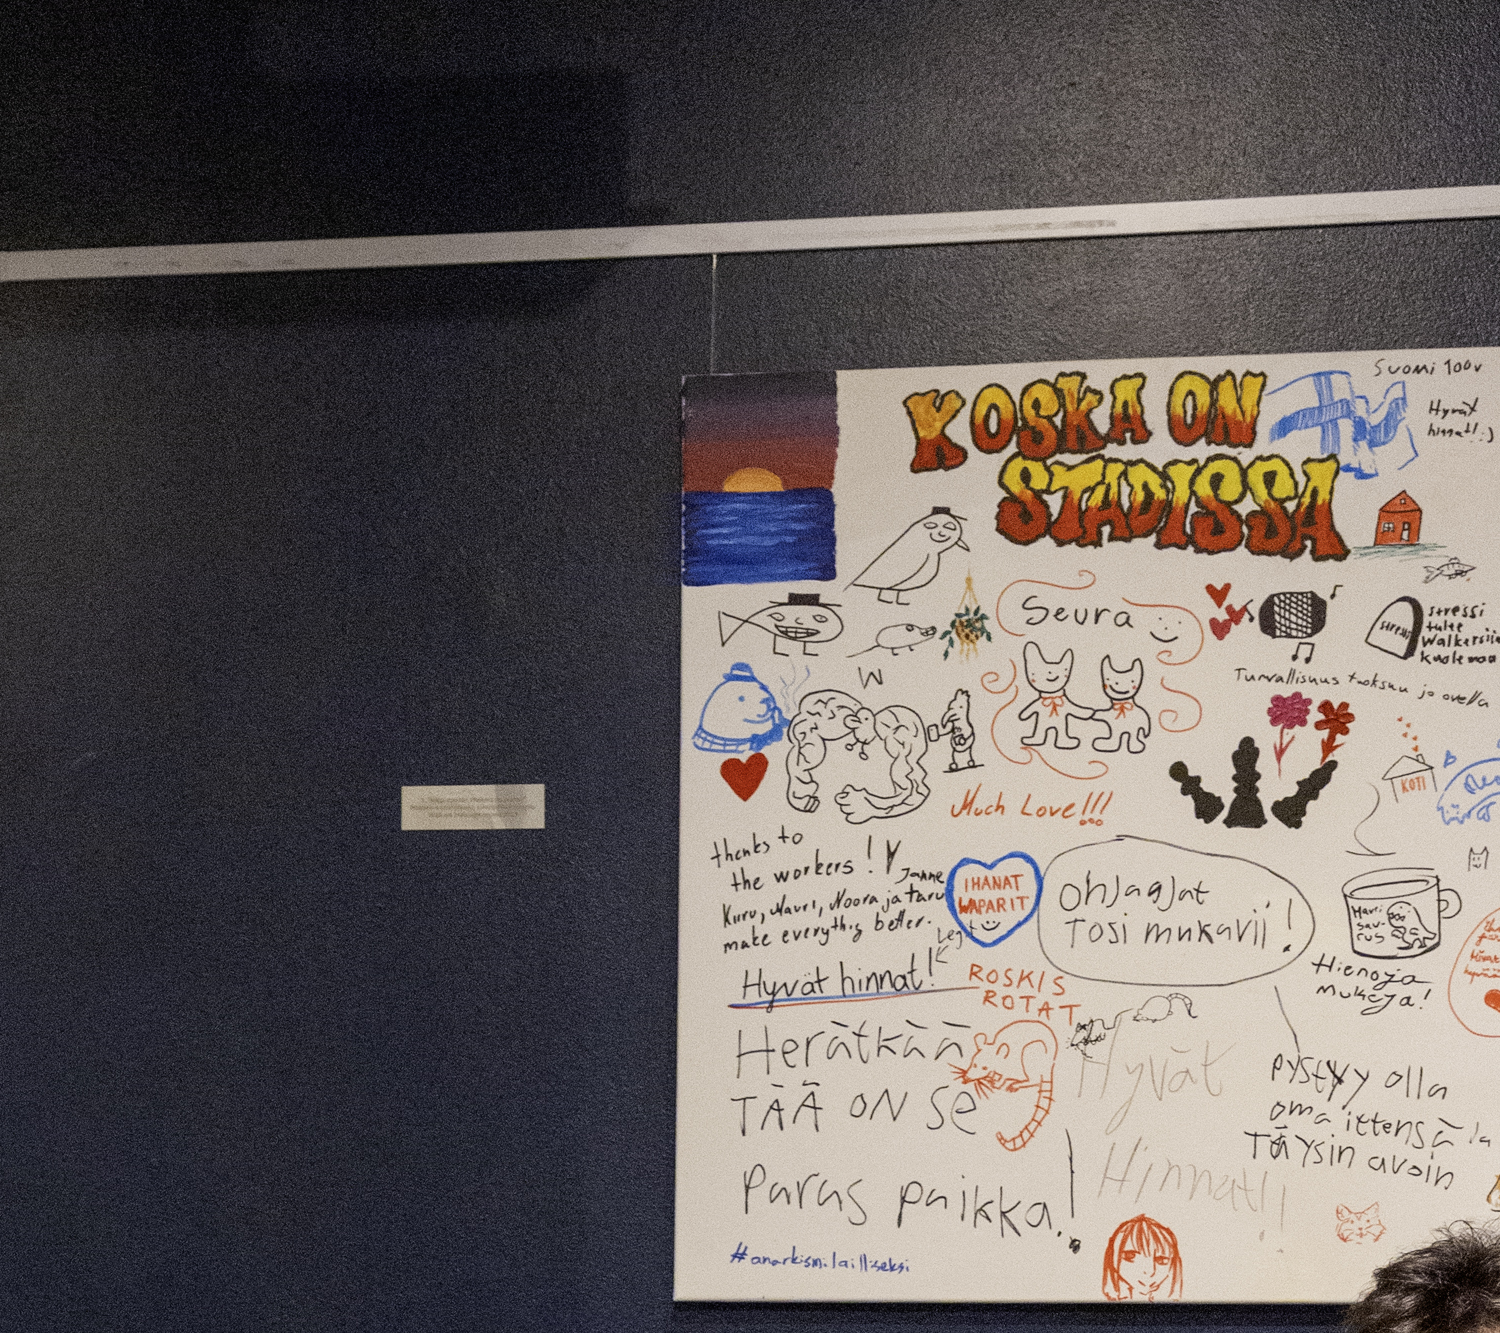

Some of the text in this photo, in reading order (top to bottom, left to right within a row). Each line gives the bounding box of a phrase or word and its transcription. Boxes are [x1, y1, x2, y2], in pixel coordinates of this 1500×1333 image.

[1374, 358, 1436, 377] Suomi
[902, 369, 1268, 474] KOSKA ON
[995, 453, 1352, 562] STADISSA
[1022, 594, 1133, 628] Seura
[1428, 602, 1486, 619] stressi
[950, 783, 1005, 818] Much
[1401, 776, 1426, 795] KOTI
[777, 824, 804, 845] to
[730, 866, 765, 892] the
[964, 874, 1024, 893] IHANAT
[881, 890, 902, 914] ja
[723, 925, 772, 954] make
[742, 966, 830, 1013] Hyvät
[968, 962, 1067, 997] ROSKIS
[982, 988, 1081, 1027] ROTAT
[735, 1019, 972, 1080] Herätkää
[1385, 1064, 1448, 1101] olla
[730, 1079, 824, 1137] TÄÄ
[1269, 1100, 1331, 1125] oma
[1367, 1150, 1455, 1191] avoin
